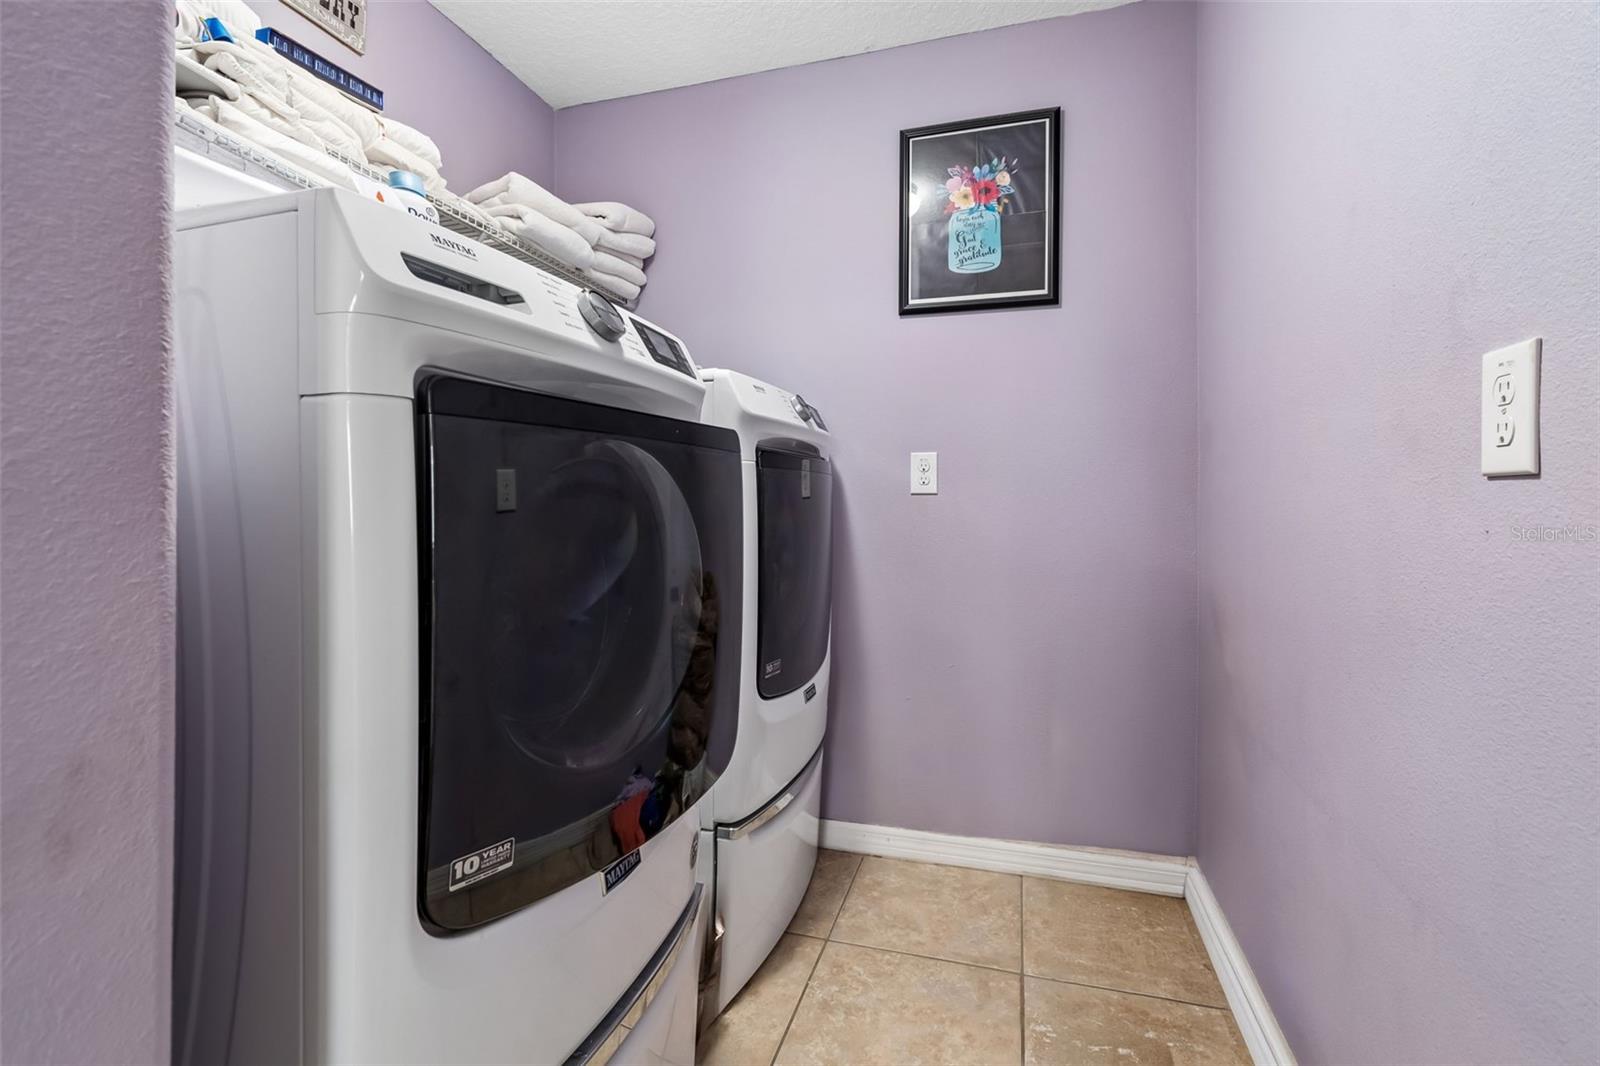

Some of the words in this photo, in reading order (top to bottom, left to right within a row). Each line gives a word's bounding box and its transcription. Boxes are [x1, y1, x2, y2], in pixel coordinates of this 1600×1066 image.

[430, 232, 476, 257] MAYTAG
[953, 245, 977, 258] grace
[980, 239, 985, 249] &
[955, 230, 976, 249] God
[957, 246, 997, 265] gratitude
[454, 855, 480, 880] 10
[482, 841, 512, 858] YEAR
[606, 851, 639, 888] MAYTAG
